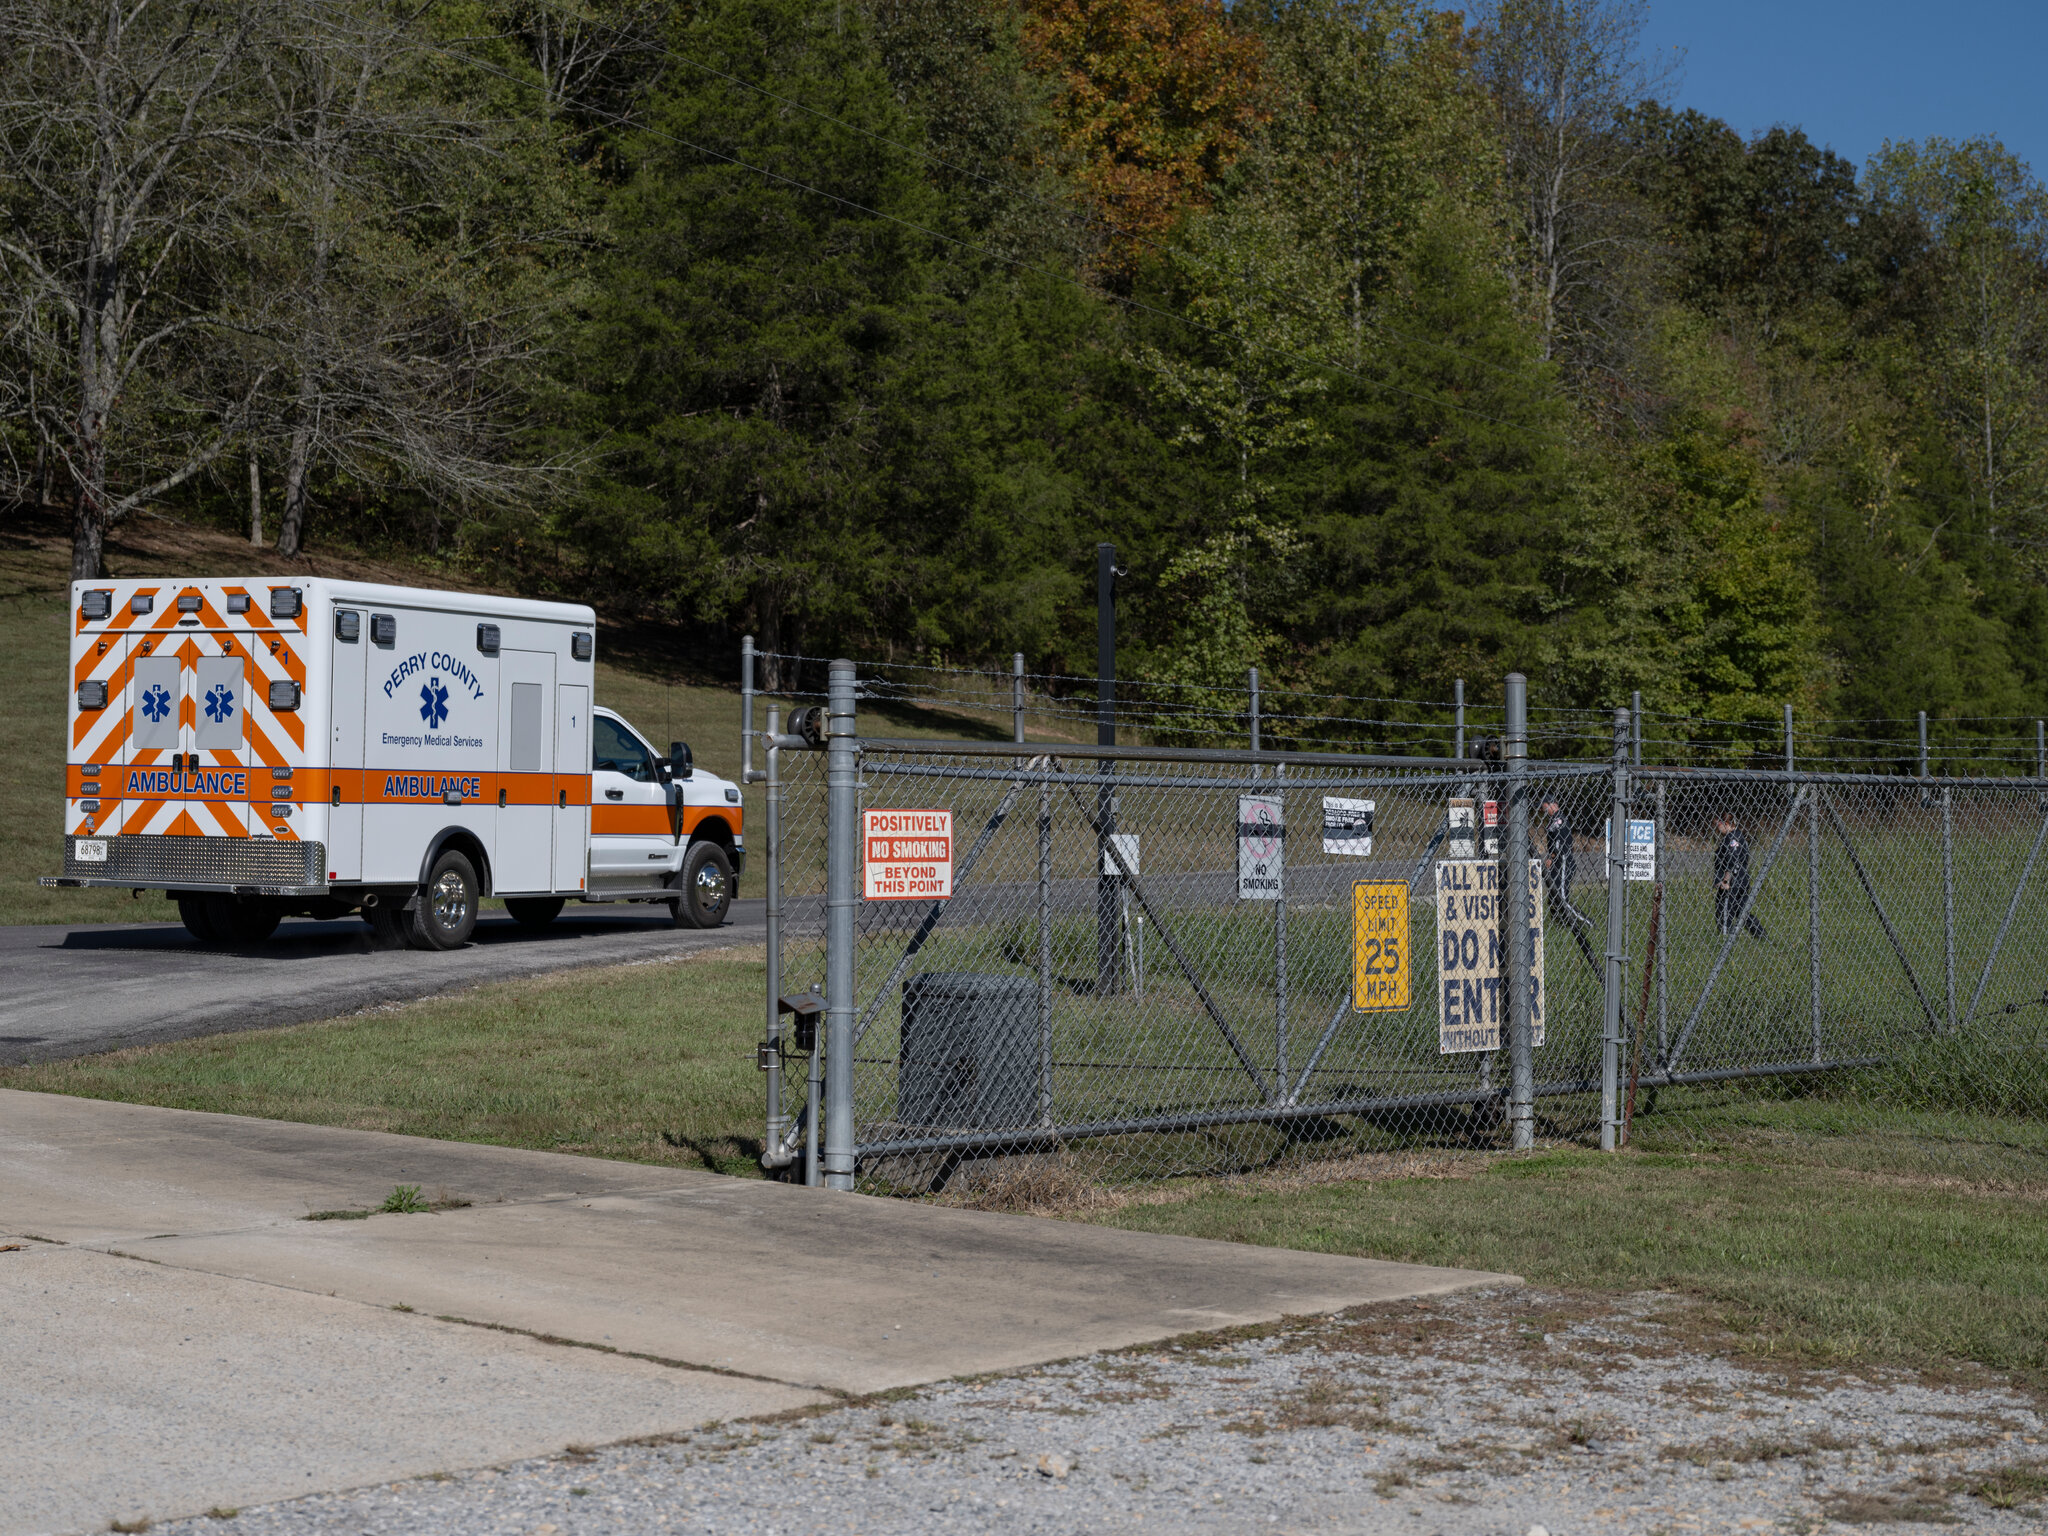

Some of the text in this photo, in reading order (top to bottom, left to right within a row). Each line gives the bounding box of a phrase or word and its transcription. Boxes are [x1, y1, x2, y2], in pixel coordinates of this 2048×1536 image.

[282, 651, 289, 665] 1
[383, 651, 484, 700] PERRY COUNTY
[571, 715, 576, 728] 1
[382, 732, 483, 747] Emergency Medical Services
[126, 771, 246, 795] AMBULANCE
[383, 775, 480, 798] AMBULANCE
[870, 815, 947, 831] POSITIVELY
[872, 841, 947, 859] NO SMOKING
[885, 866, 937, 879] BEYOND
[1255, 864, 1267, 875] NO
[1440, 865, 1472, 890] ALL
[875, 880, 945, 893] THIS POINT
[1243, 878, 1279, 890] SMOKING
[1364, 895, 1398, 910] SPEED
[1446, 895, 1458, 920] &
[1368, 917, 1396, 932] LIMIT
[1365, 938, 1400, 976] 25
[1443, 927, 1540, 971] DO NT
[1367, 981, 1397, 1001] MPH
[1444, 976, 1541, 1025] ENTR
[1443, 1029, 1496, 1049] WITHOUT
